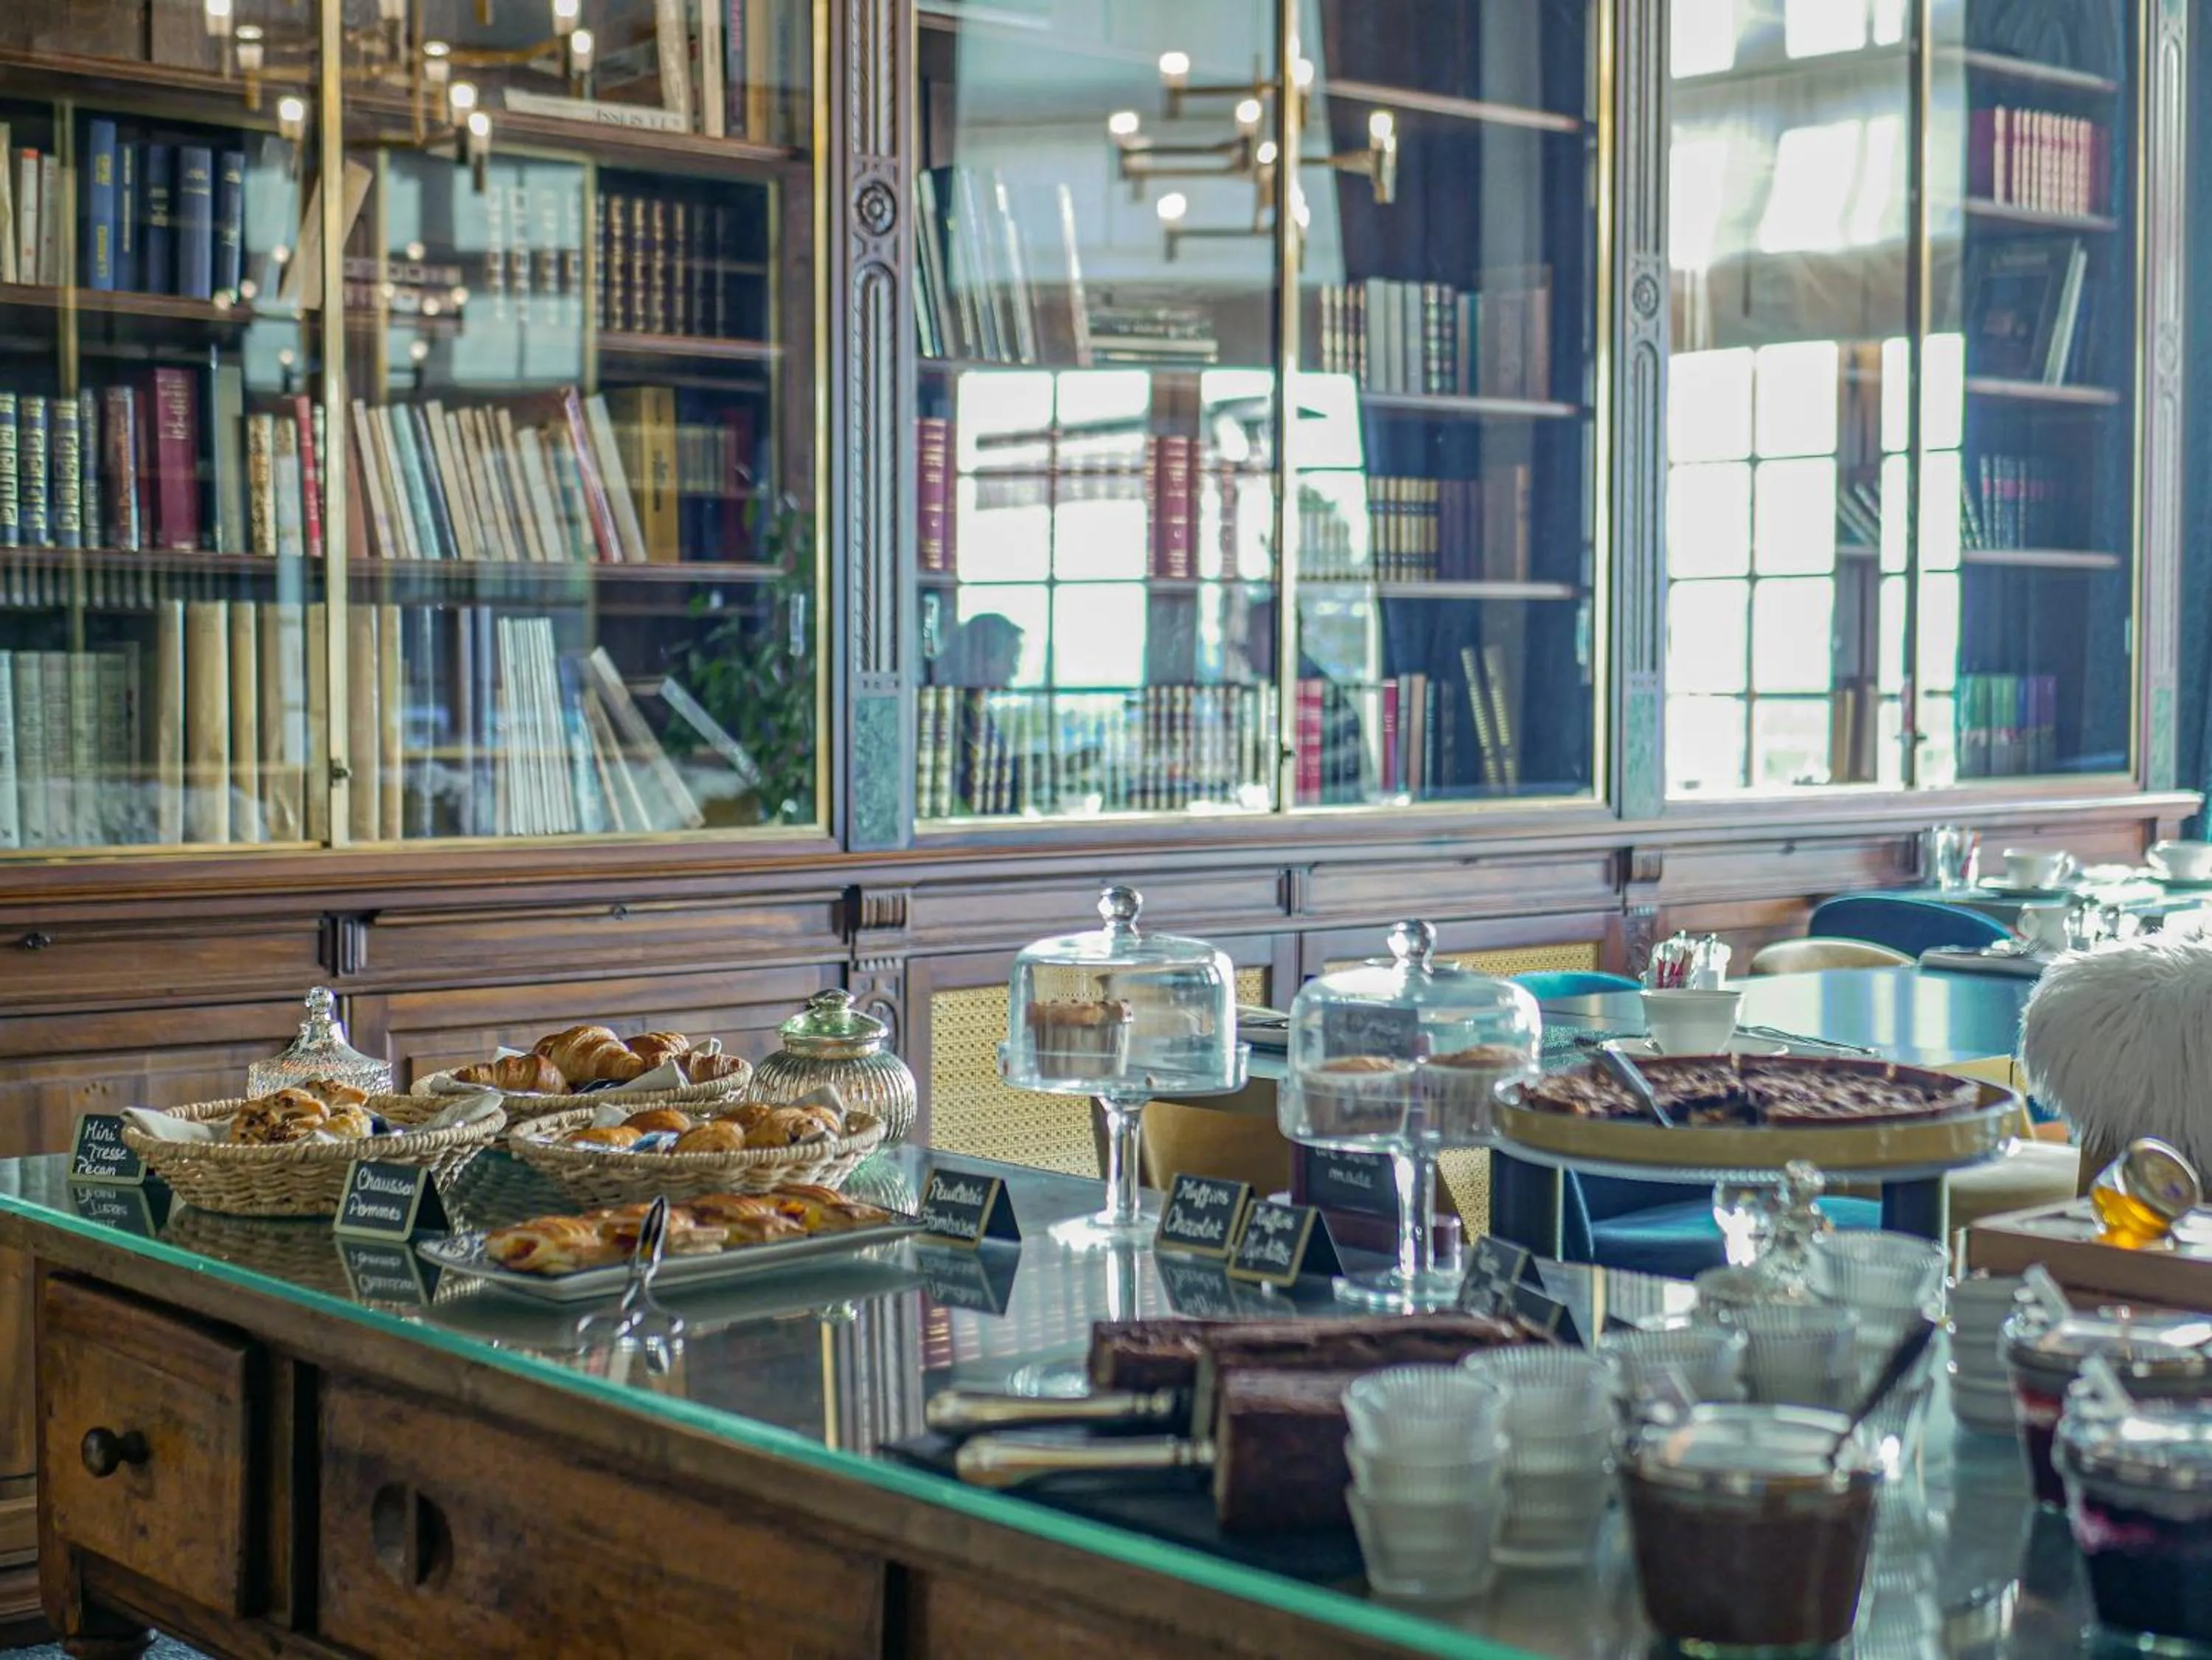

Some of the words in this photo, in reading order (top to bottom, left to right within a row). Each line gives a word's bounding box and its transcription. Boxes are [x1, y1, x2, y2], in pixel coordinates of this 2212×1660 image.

[85, 1120, 116, 1142] Mini
[88, 1143, 127, 1162] Tresse
[349, 1192, 402, 1221] Pommes
[1176, 1179, 1229, 1209] Muffins
